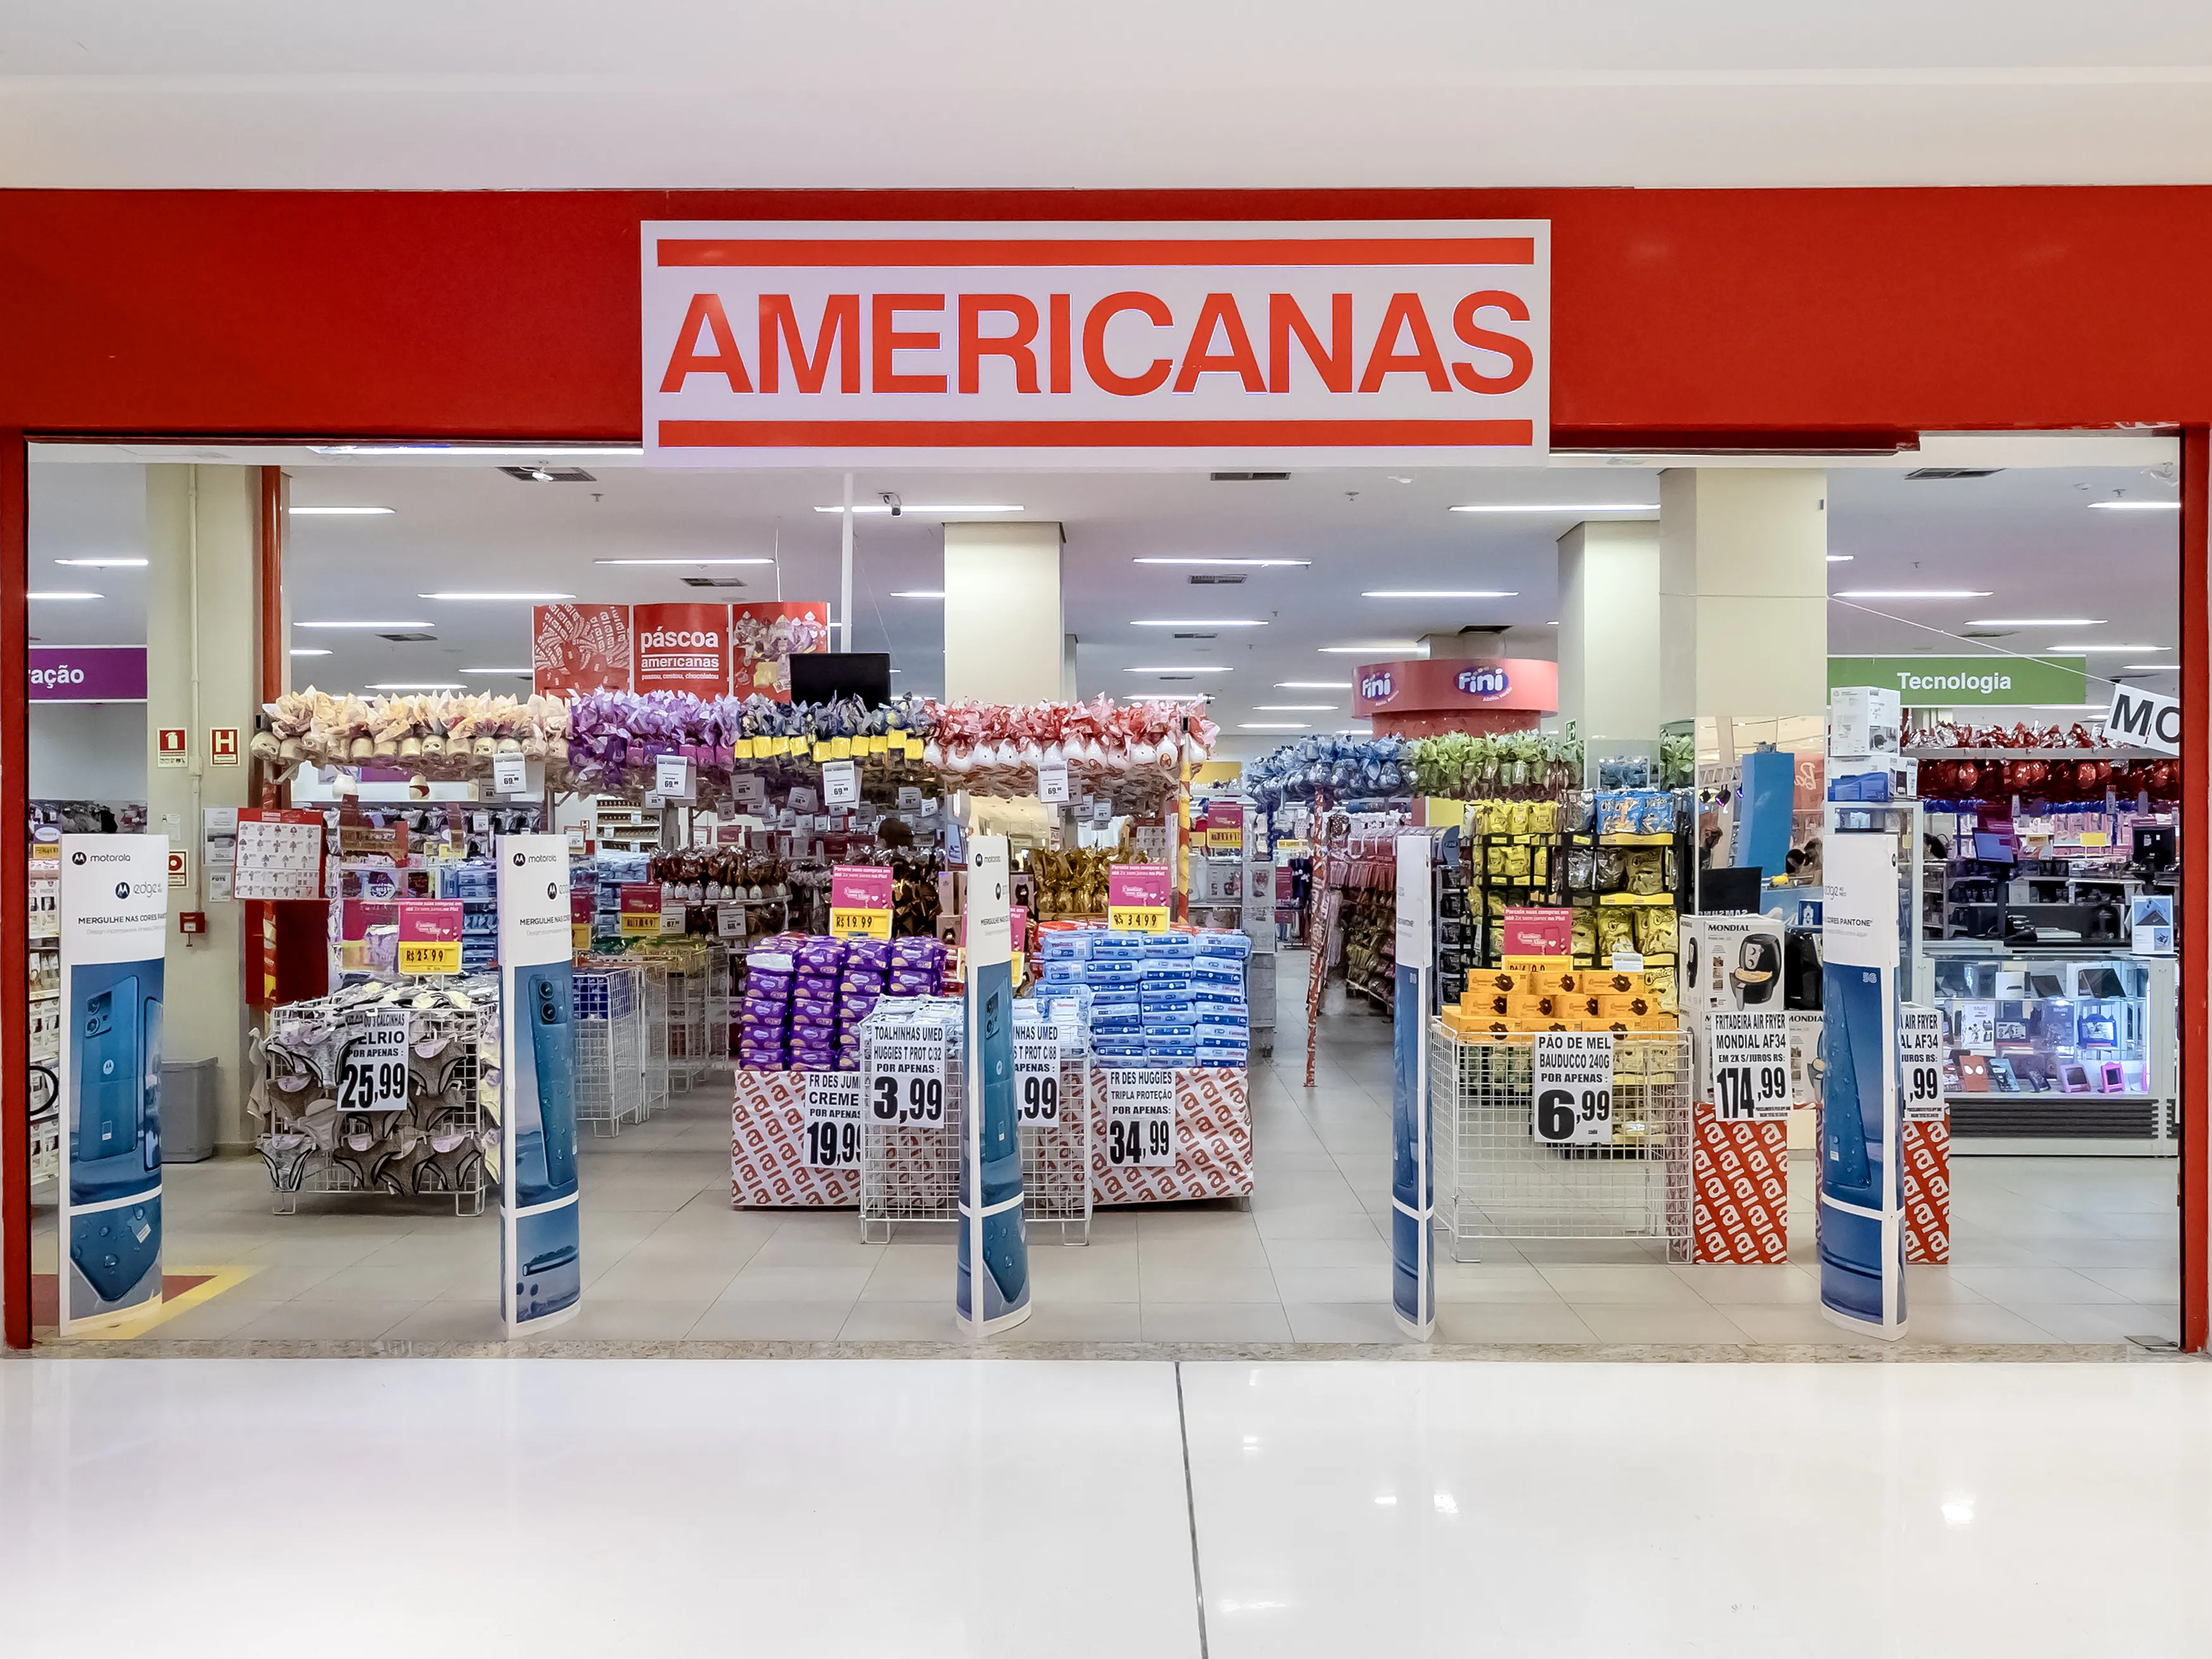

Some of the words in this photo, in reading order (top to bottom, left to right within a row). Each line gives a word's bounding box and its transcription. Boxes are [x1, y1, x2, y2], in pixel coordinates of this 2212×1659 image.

[659, 291, 1534, 396] AMERICANAS
[640, 626, 719, 653] páscoa
[641, 655, 719, 668] americanas
[28, 665, 84, 689] ação
[1459, 668, 1503, 693] Fini
[1897, 672, 2012, 694] Tecnologia
[1362, 672, 1390, 698] Fini
[216, 731, 234, 752] H
[90, 854, 131, 862] motorola
[528, 854, 557, 863] motorola
[133, 882, 157, 897] edge
[520, 917, 554, 925] MERGULHE
[836, 916, 844, 928] R$
[1114, 913, 1123, 925] R$
[406, 950, 414, 962] R$
[1863, 972, 1877, 983] 5G
[1715, 1014, 1751, 1030] FRITADEIRA
[1753, 1014, 1764, 1029] AIR
[1765, 1014, 1785, 1029] FRYER
[1905, 1014, 1916, 1029] AIR
[1917, 1014, 1938, 1030] FRYER
[359, 1031, 404, 1045] LRIO
[875, 1026, 920, 1041] TOALHINHAS
[922, 1027, 943, 1042] UMED
[1037, 1026, 1058, 1040] UMED
[1539, 1034, 1563, 1049] PÃO
[1567, 1036, 1583, 1049] DE
[1586, 1036, 1611, 1049] MEL
[1716, 1034, 1760, 1049] MONDIAL
[1763, 1033, 1786, 1048] AF34
[1915, 1034, 1938, 1048] AF34
[367, 1048, 398, 1057] APENAS
[874, 1046, 902, 1060] HUGGIES
[903, 1047, 908, 1060] T
[910, 1047, 927, 1060] PROT
[1024, 1046, 1042, 1059] PROT
[1741, 1054, 1771, 1062] S/JUROS
[877, 1063, 896, 1073] POR
[897, 1064, 935, 1073] APENAS
[1015, 1063, 1050, 1073] APENAS
[1540, 1054, 1586, 1068] BAUDUCCO
[1589, 1054, 1610, 1068] 240G
[809, 1074, 820, 1087] FR
[822, 1075, 838, 1088] DES
[841, 1076, 860, 1089] JUM
[1110, 1072, 1120, 1085] FR
[1122, 1072, 1136, 1085] DES
[1139, 1071, 1172, 1085] HUGGIES
[1541, 1073, 1562, 1082] POR
[1565, 1074, 1602, 1083] APENAS
[340, 1062, 405, 1109] 25,99
[1717, 1066, 1786, 1119] 174,99
[873, 1076, 943, 1124] 3,99
[1111, 1091, 1134, 1100] TRIPLA
[1136, 1088, 1172, 1102] PROTEÇÃO
[810, 1109, 827, 1117] POR
[1133, 1106, 1171, 1114] APENAS:
[1538, 1089, 1610, 1140] 6,99
[1110, 1121, 1169, 1164] 34,99
